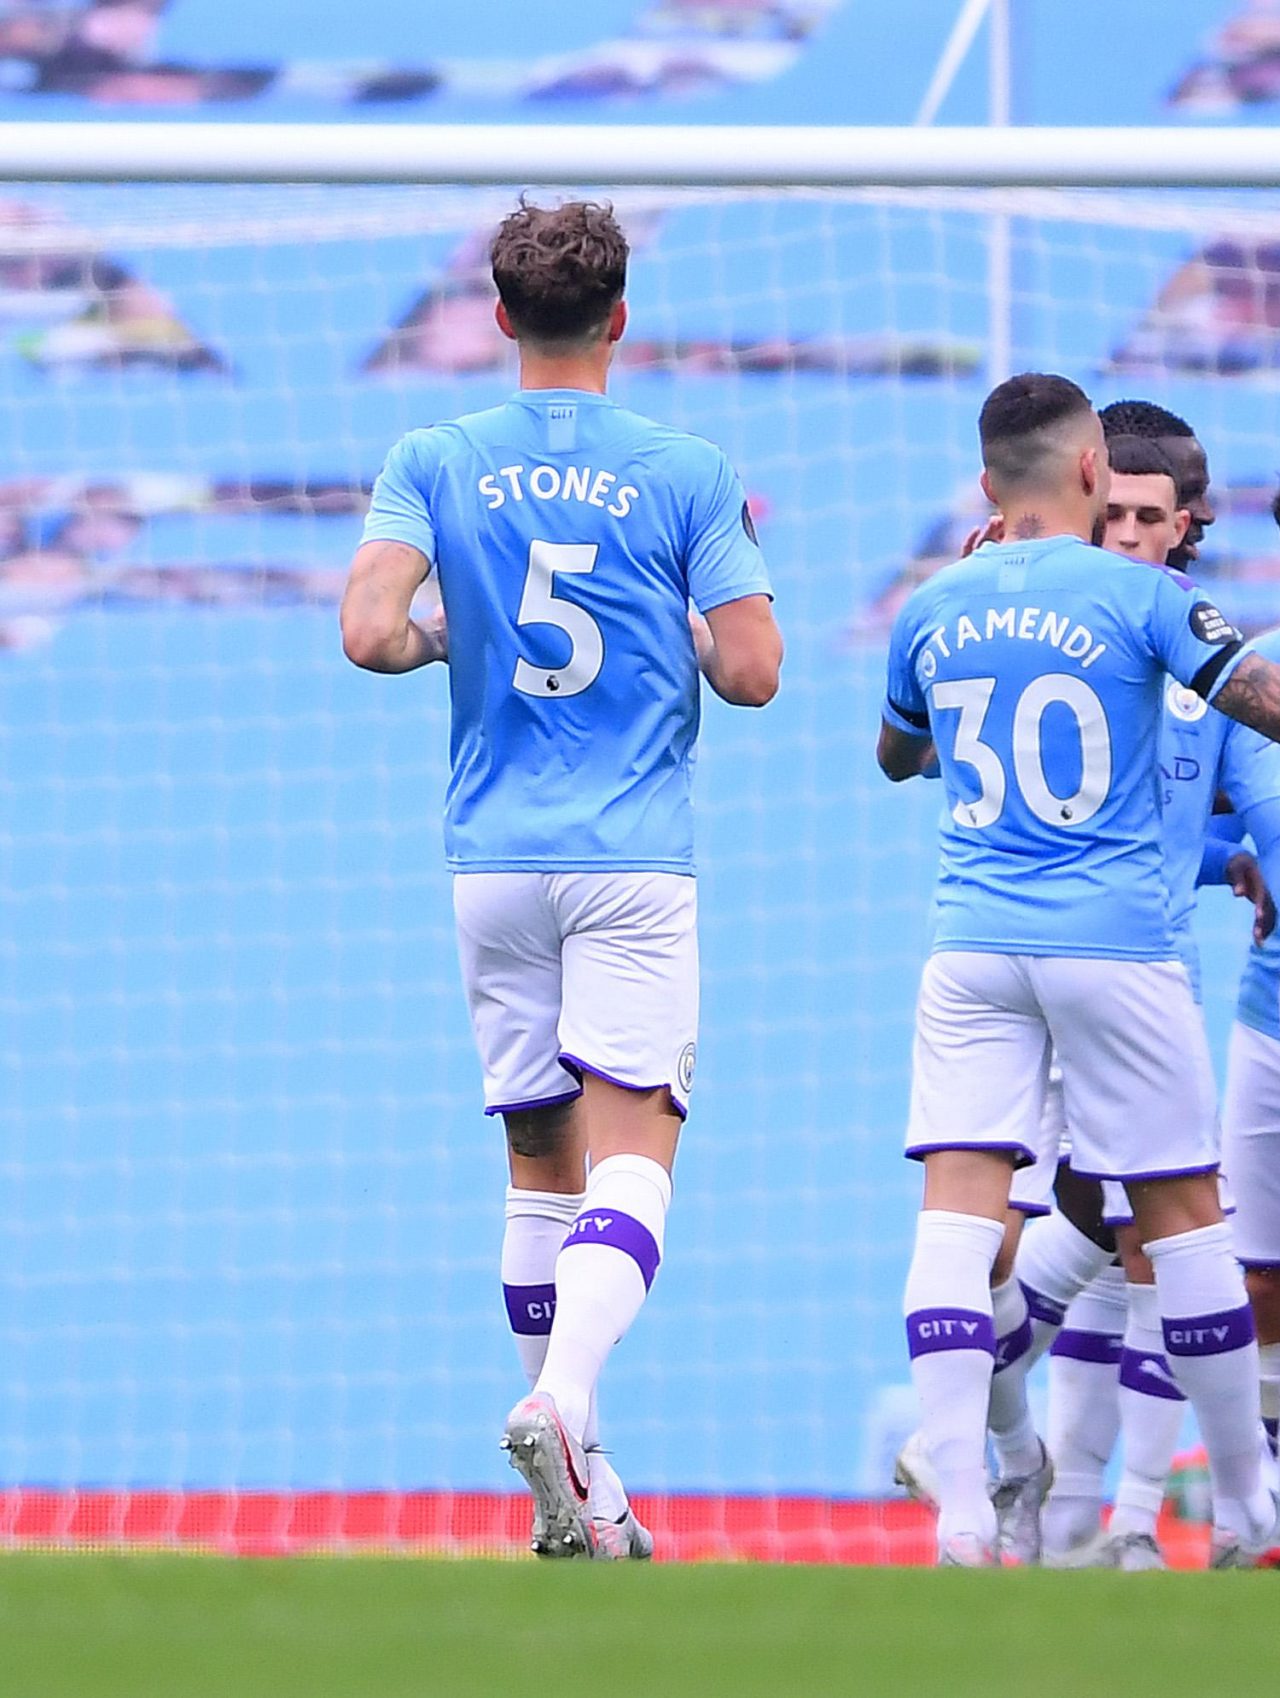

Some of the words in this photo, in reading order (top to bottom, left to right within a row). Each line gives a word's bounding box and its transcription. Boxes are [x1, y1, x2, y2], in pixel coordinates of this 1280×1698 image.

[478, 464, 640, 518] STONES
[512, 538, 605, 698] 5
[922, 607, 1107, 678] OTAMENDI
[931, 671, 1112, 830] 30
[570, 1216, 613, 1236] ITY
[918, 1319, 979, 1338] CITY
[1169, 1324, 1230, 1344] CITY
